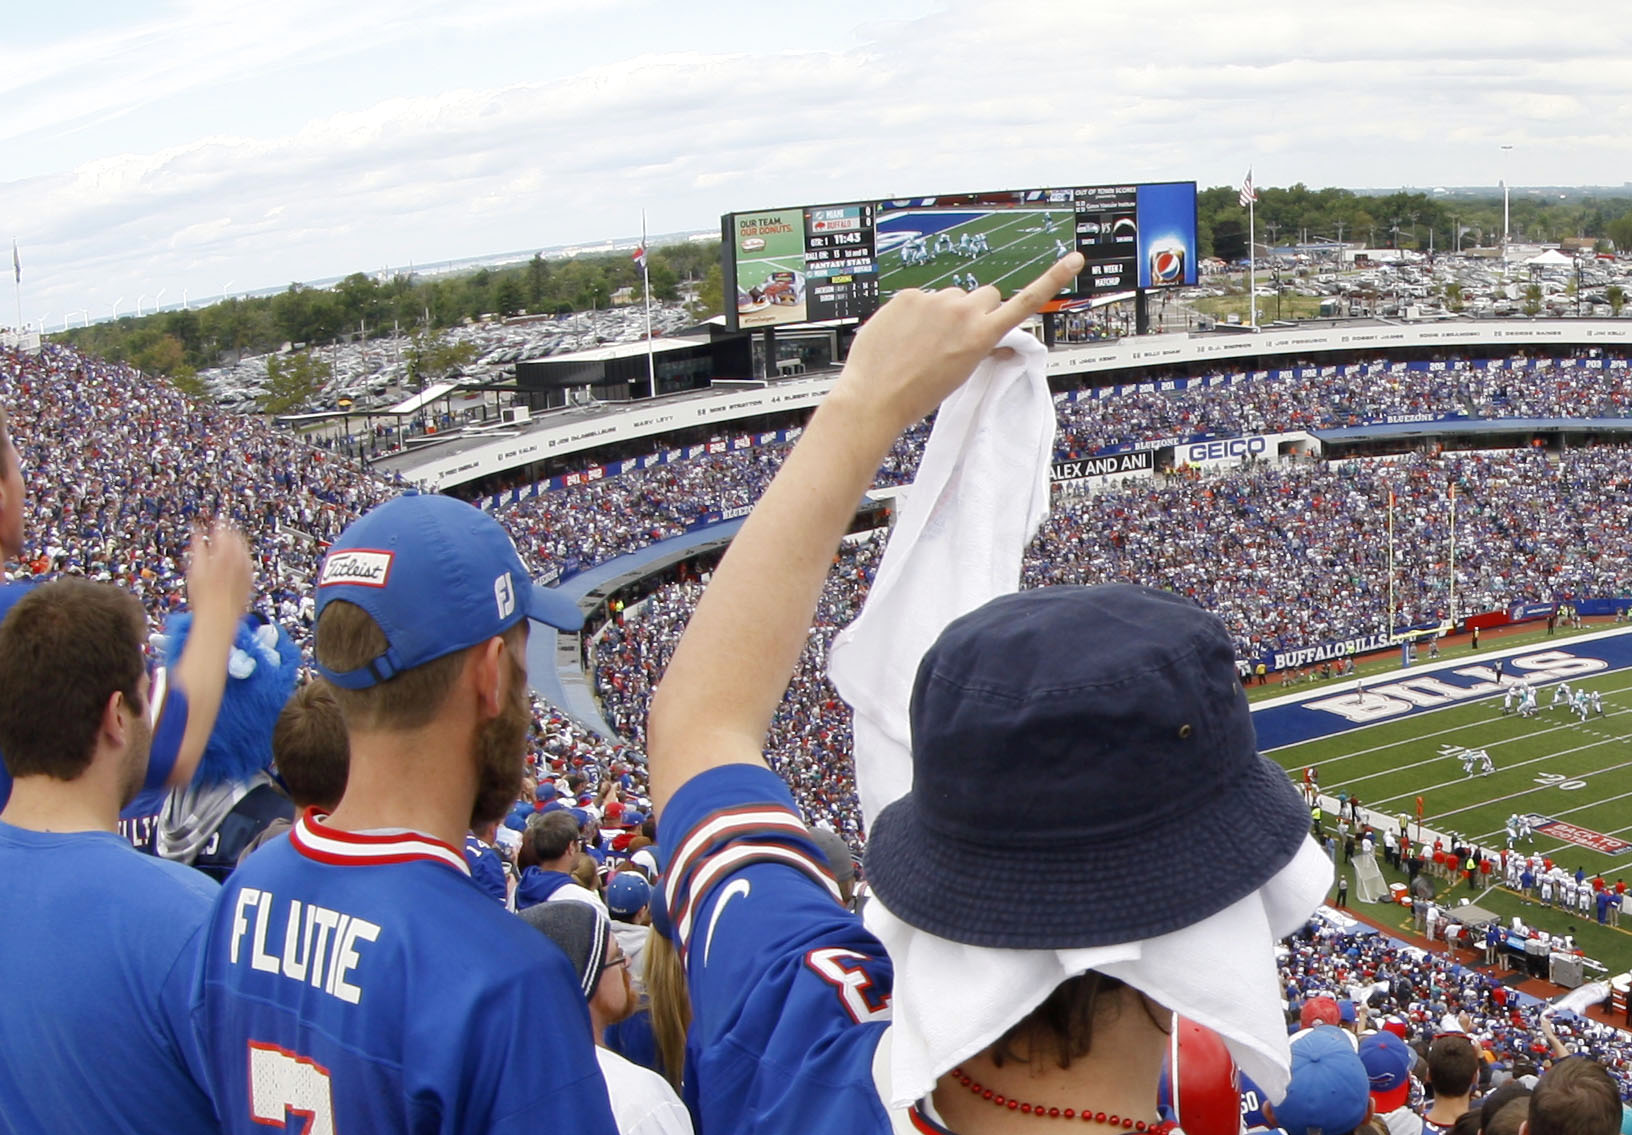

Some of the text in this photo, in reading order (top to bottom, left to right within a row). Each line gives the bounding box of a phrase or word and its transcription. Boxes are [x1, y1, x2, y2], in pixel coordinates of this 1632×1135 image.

[865, 206, 871, 216] 0
[740, 218, 757, 228] OUR
[827, 217, 871, 229] BUFFALO 0
[740, 227, 757, 236] OUR
[834, 232, 861, 245] 11:43
[810, 258, 871, 270] FANTASY STATS
[1092, 265, 1102, 275] NFL
[1103, 264, 1118, 274] WEEK
[1095, 277, 1120, 287] MATCHUP
[1429, 361, 1446, 371] 202
[1387, 413, 1434, 423] BLUEZONE
[1134, 437, 1179, 450] BLUEZONE
[1189, 437, 1265, 462] GEICO
[1087, 458, 1117, 475] AND
[1120, 453, 1146, 470] ANI
[323, 555, 383, 581] Titleist
[1301, 651, 1609, 723] BILLS
[1533, 772, 1588, 791] 20
[1553, 824, 1621, 847] BACK TO
[230, 887, 381, 1005] FLUTIE
